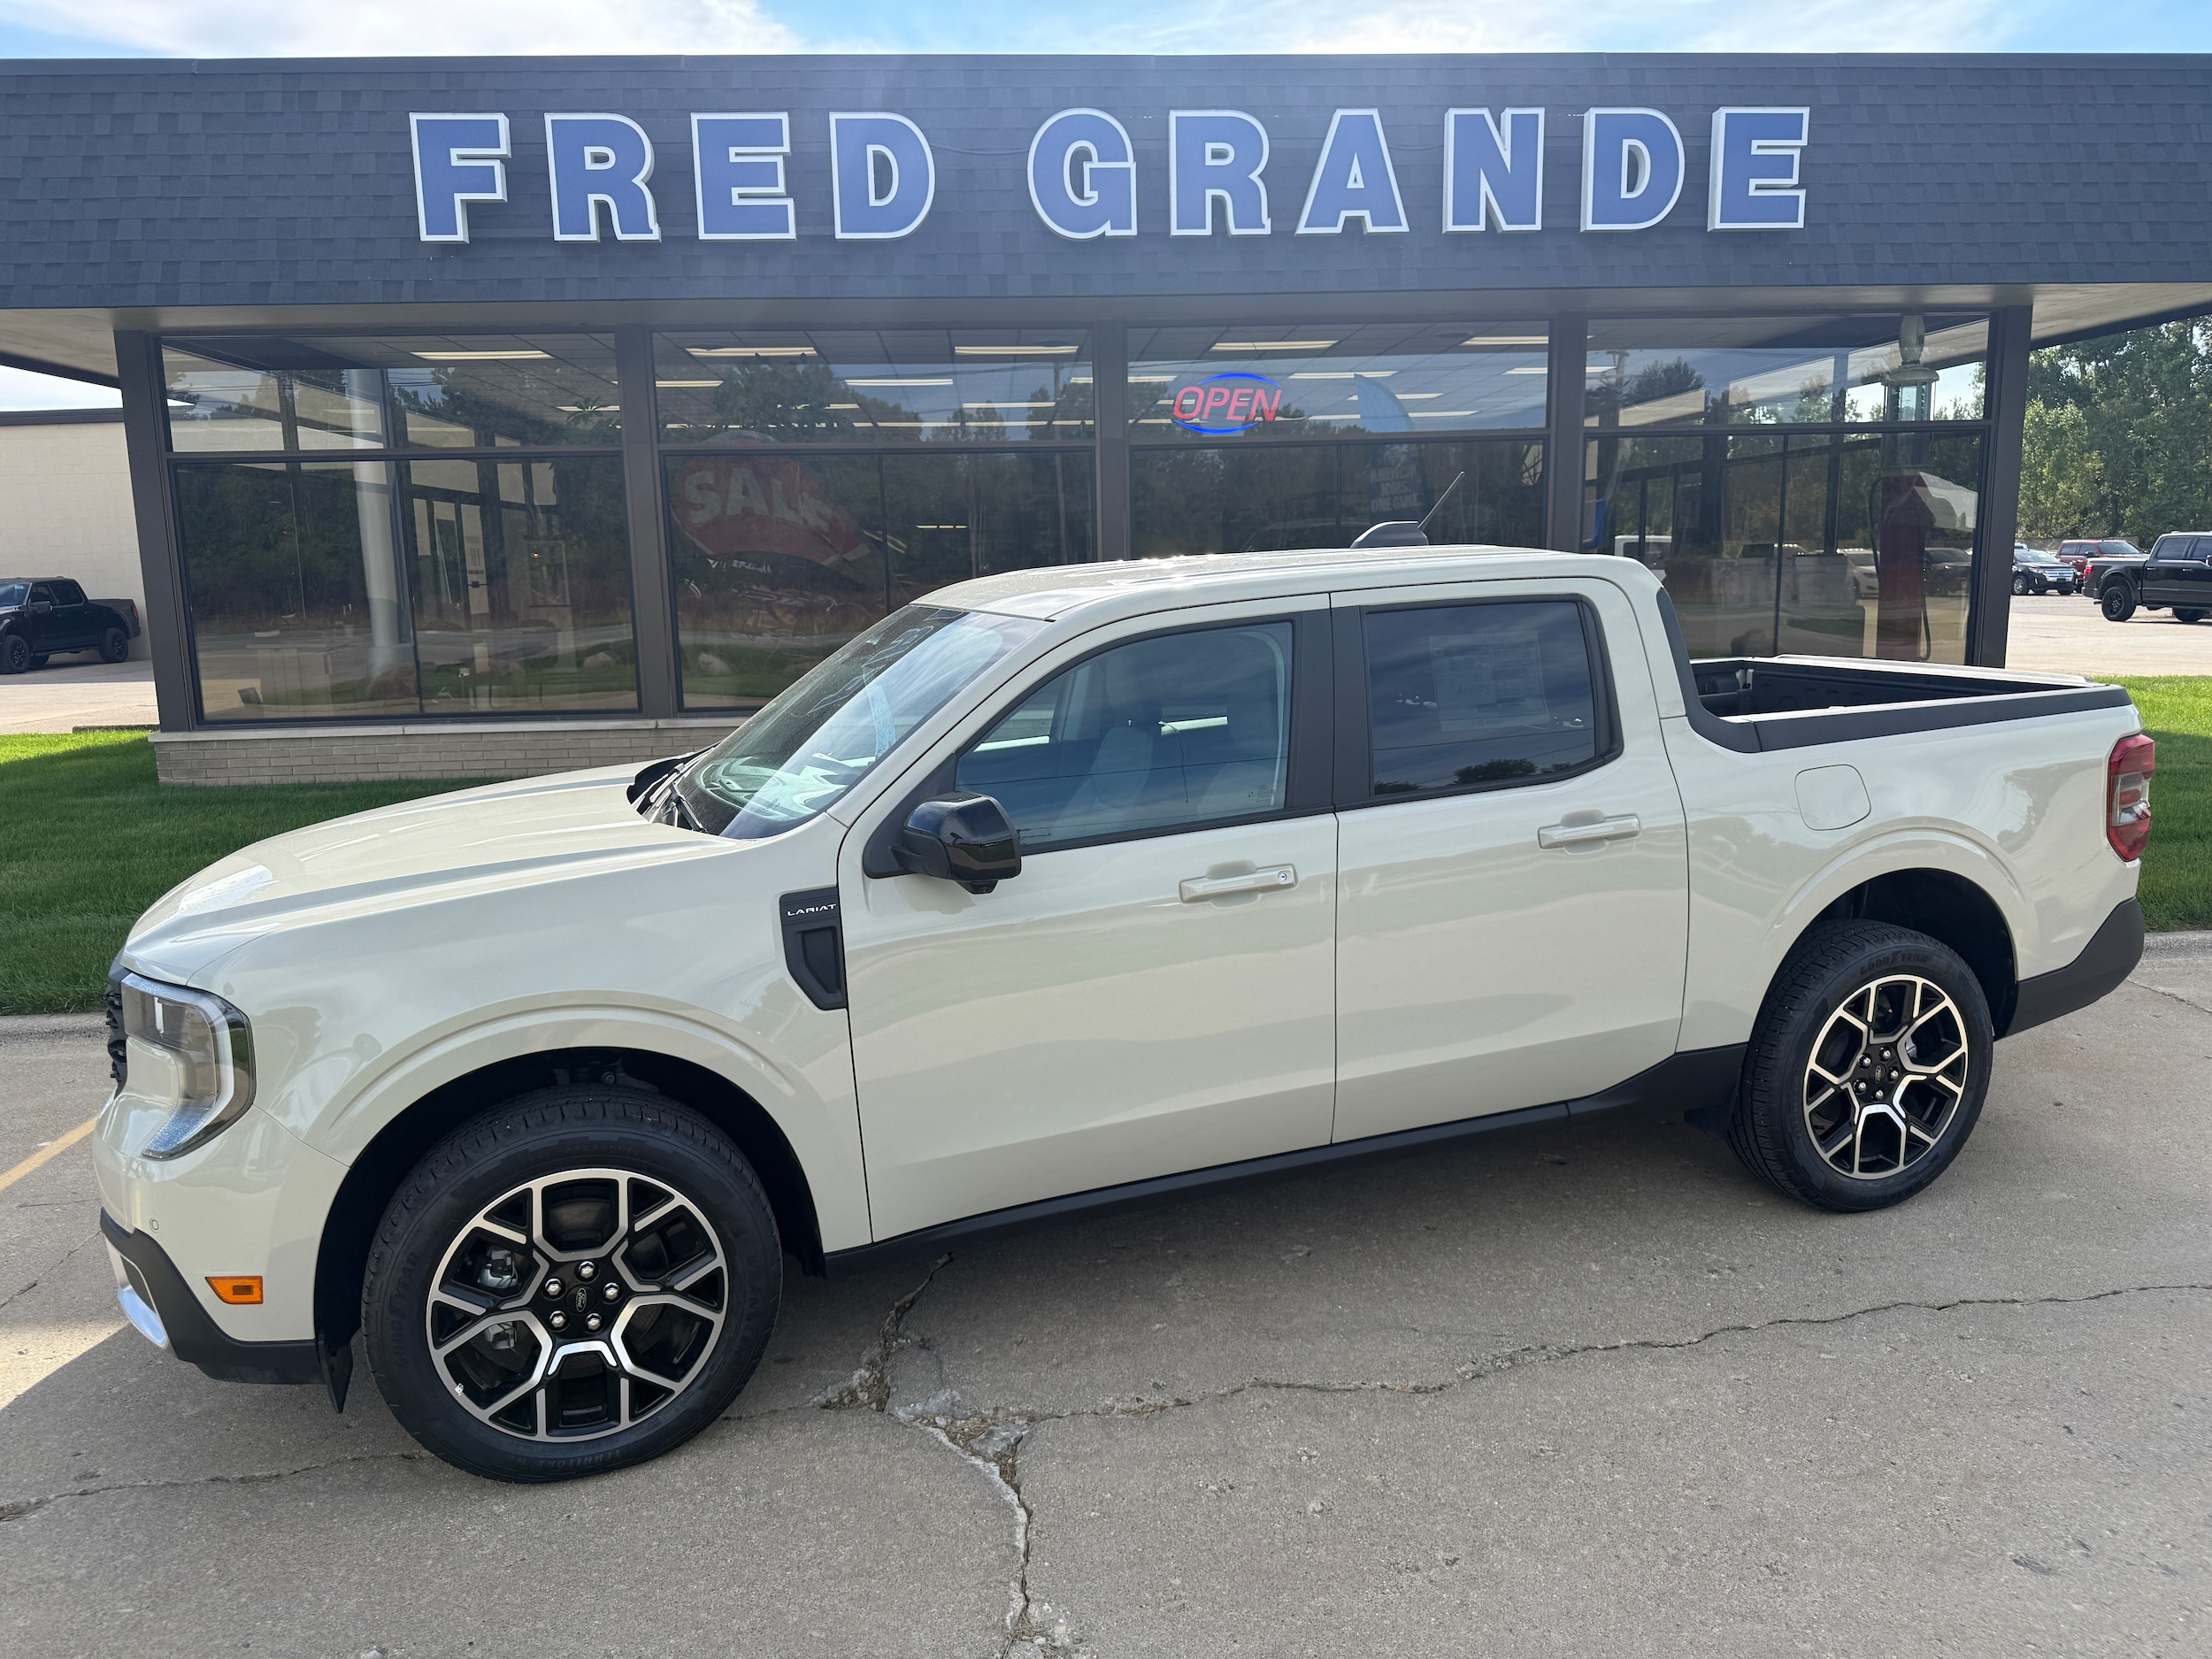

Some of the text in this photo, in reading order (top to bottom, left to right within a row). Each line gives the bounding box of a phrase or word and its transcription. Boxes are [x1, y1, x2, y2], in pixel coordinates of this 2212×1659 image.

[409, 106, 1810, 243] FRED GRANDE
[1173, 386, 1282, 422] OPEN
[684, 466, 833, 533] SALE
[787, 903, 836, 917] LARIAT
